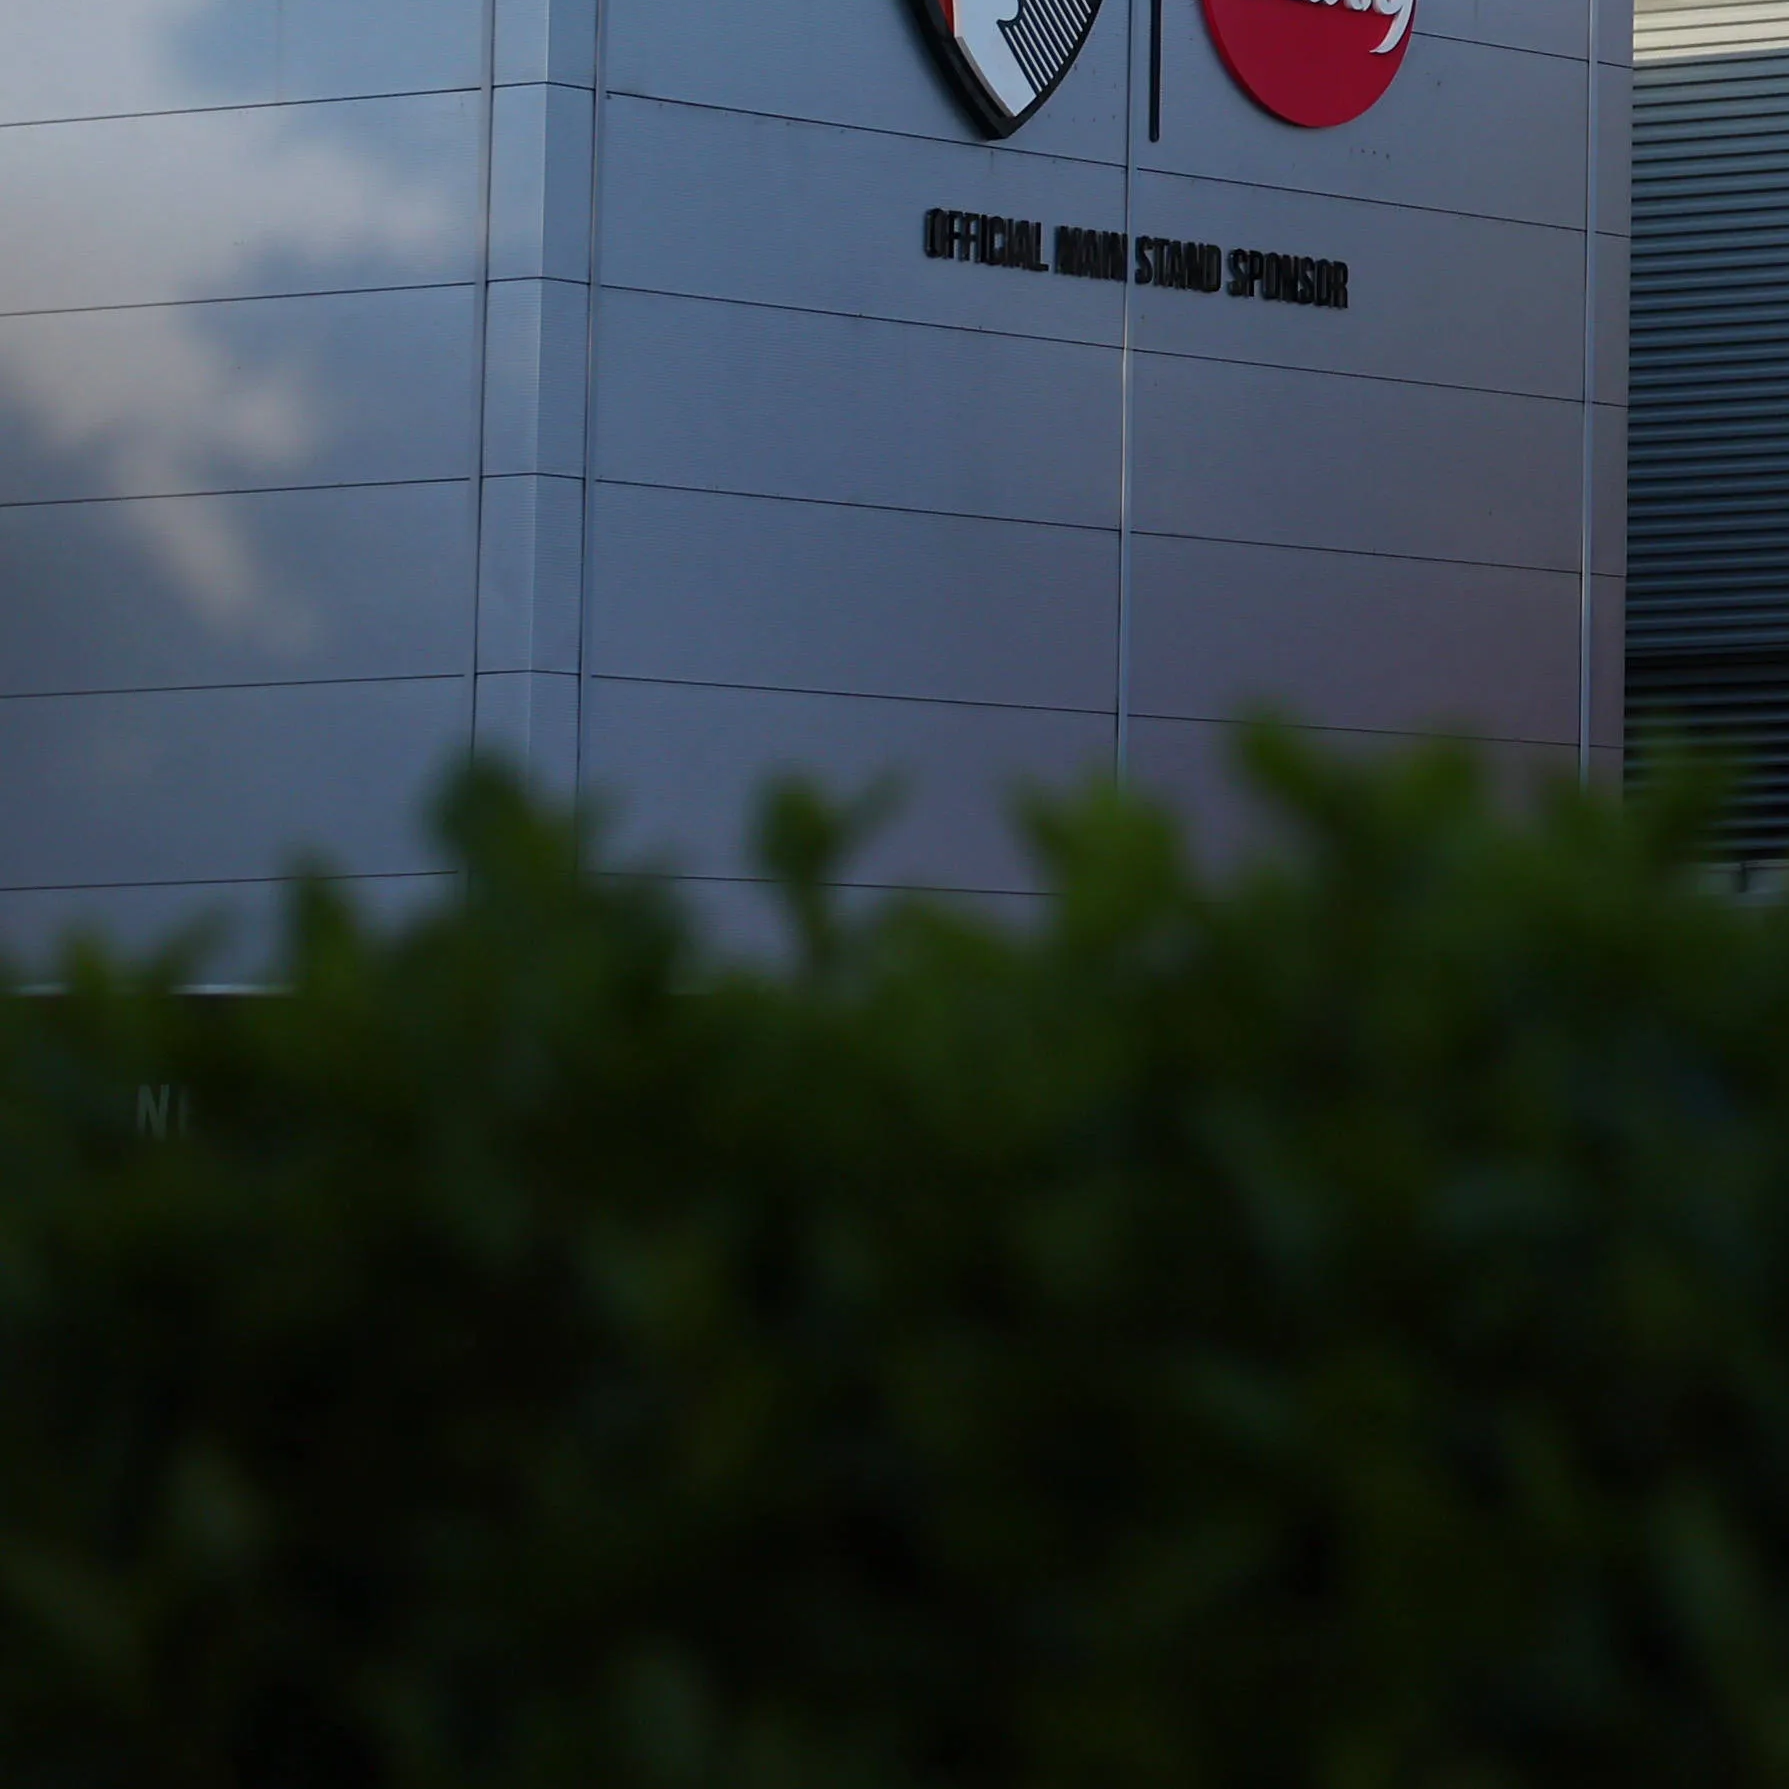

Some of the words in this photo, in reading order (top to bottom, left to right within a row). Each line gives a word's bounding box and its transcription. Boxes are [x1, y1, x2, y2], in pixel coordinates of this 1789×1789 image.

[923, 207, 1049, 272] OFFICIAL
[1054, 225, 1127, 283] MAIN
[1134, 235, 1221, 293] STAND
[1227, 247, 1348, 309] SPONSOR
